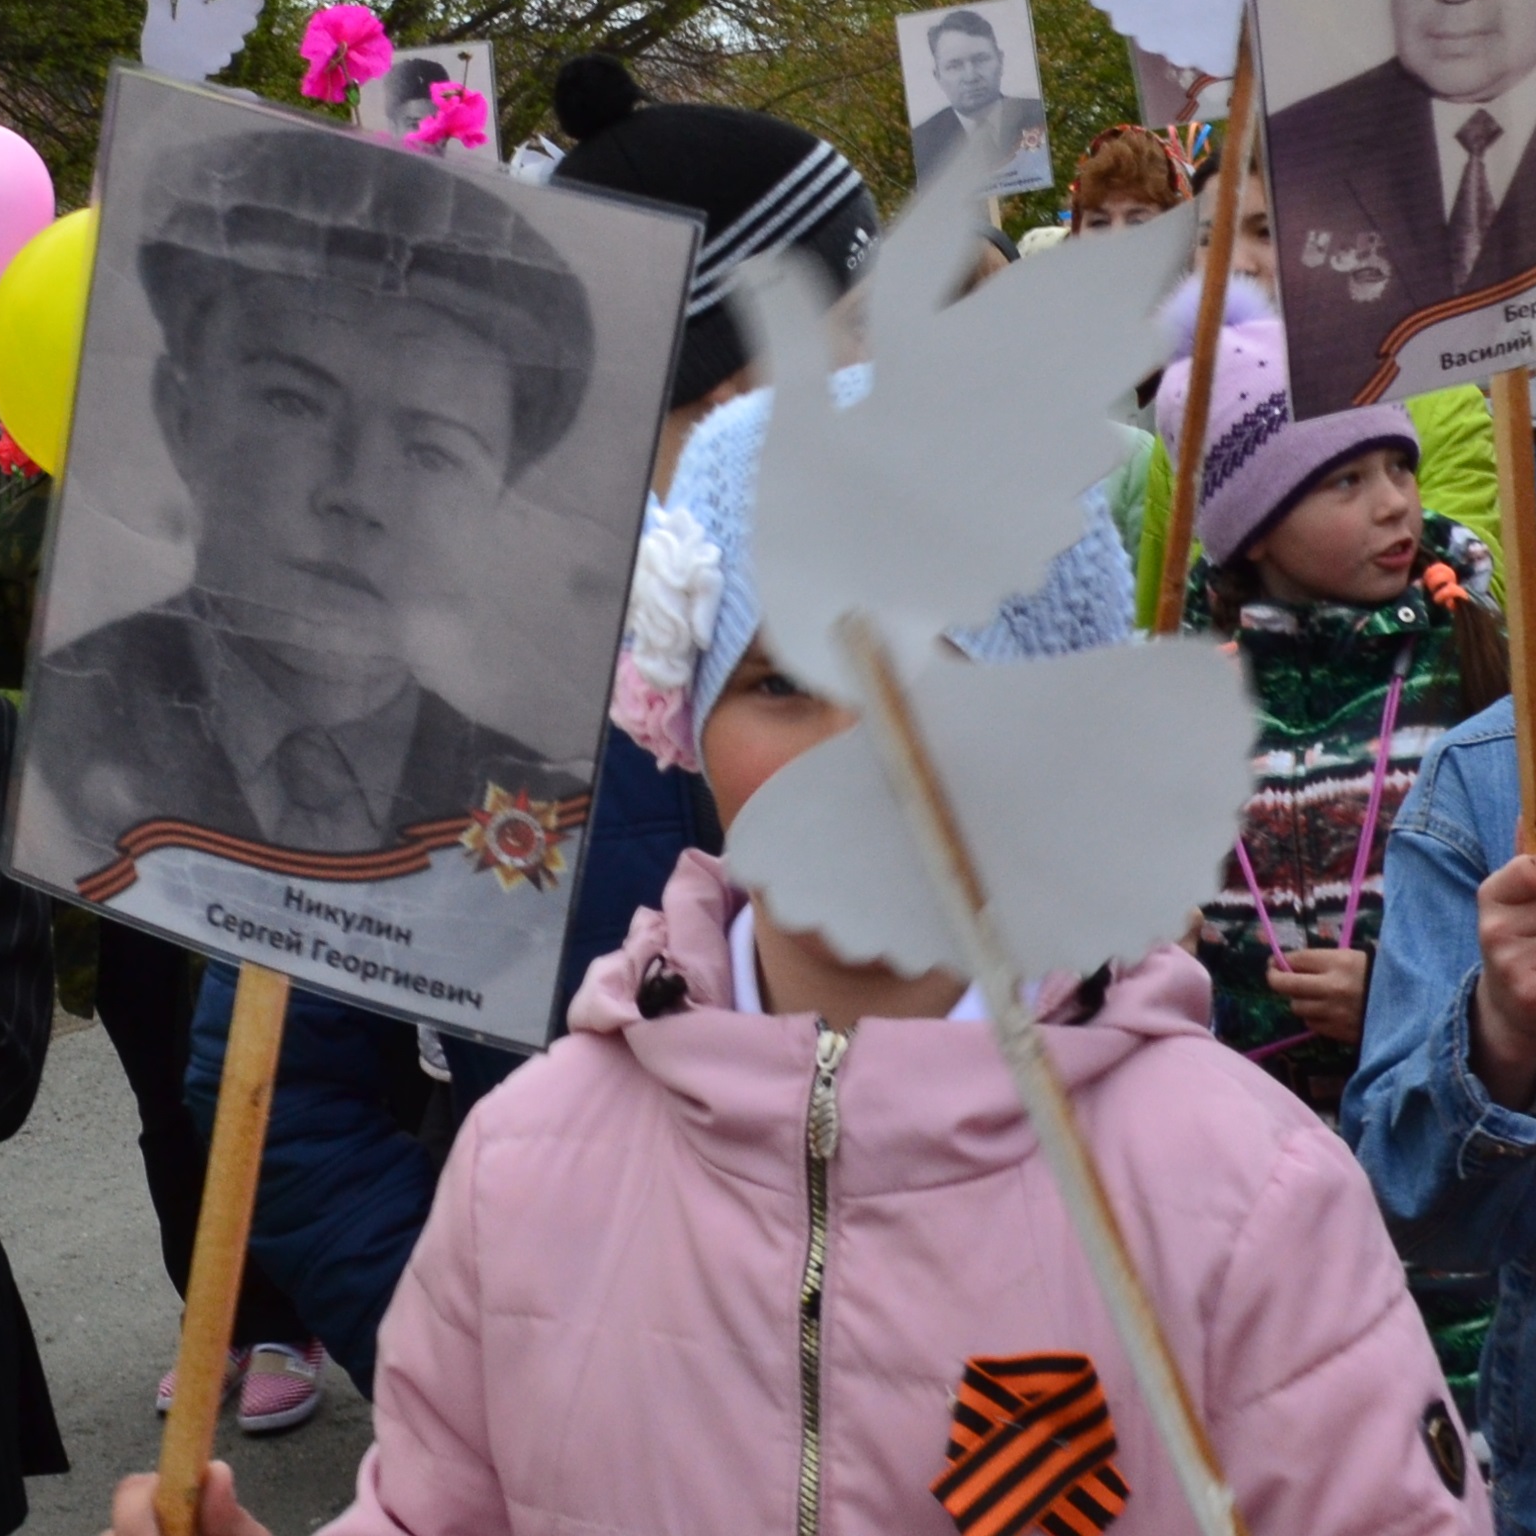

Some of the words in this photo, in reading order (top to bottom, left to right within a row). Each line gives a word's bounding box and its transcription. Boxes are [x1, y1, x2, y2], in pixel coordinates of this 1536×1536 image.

[1440, 331, 1533, 370] Василий
[284, 885, 412, 946] Никулин
[206, 904, 302, 957] Сергей
[311, 938, 483, 1011] Георгиевич
